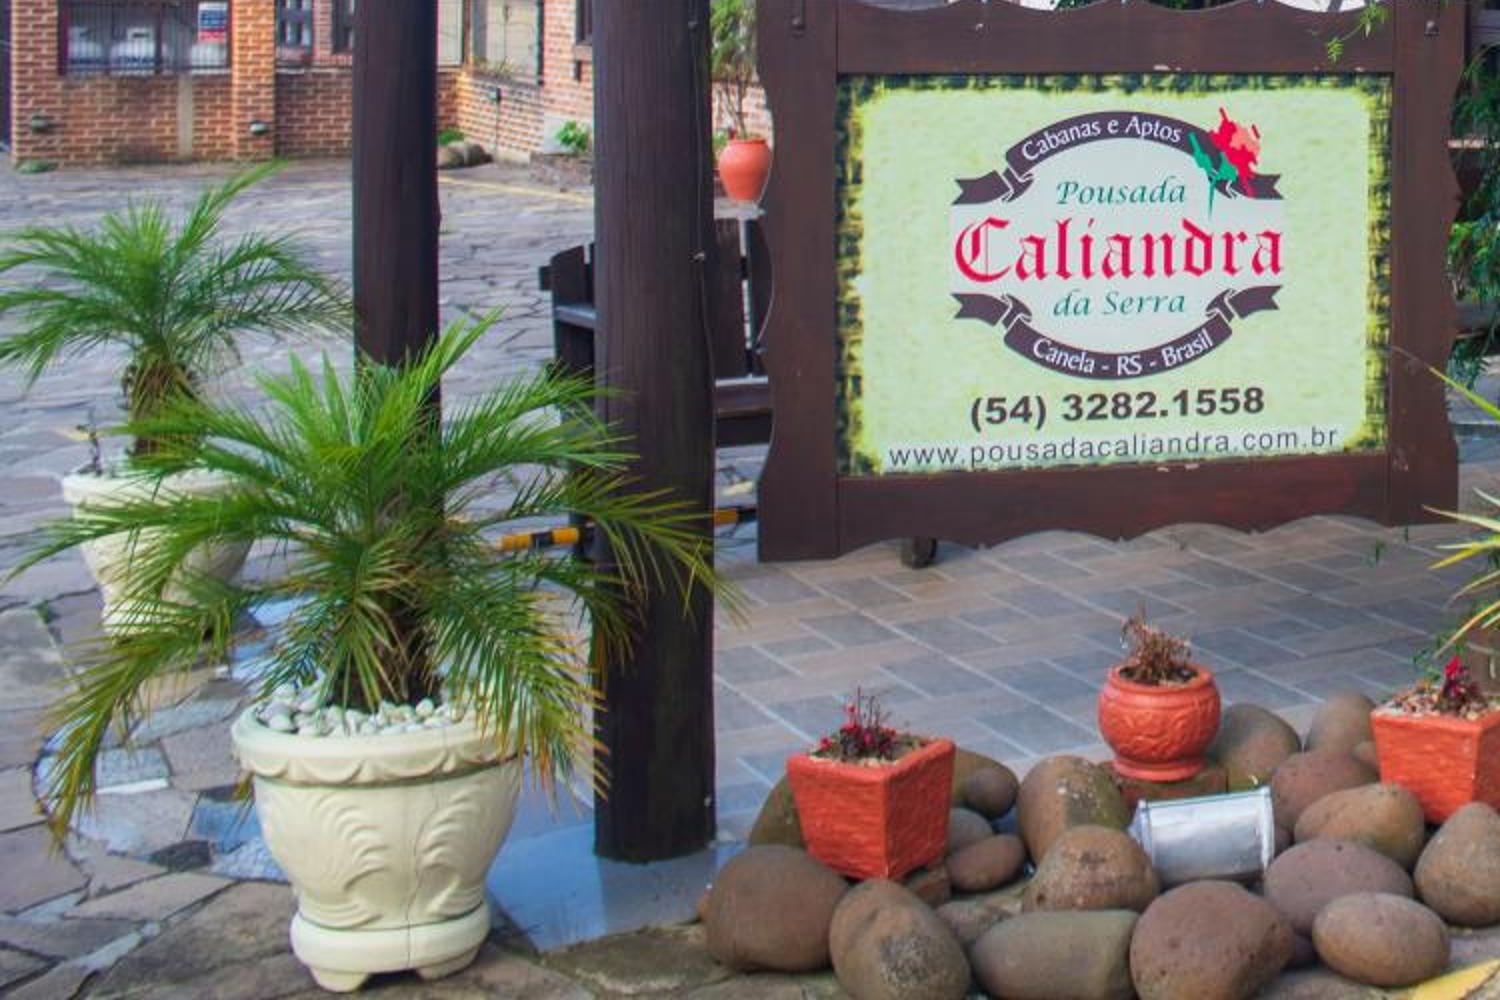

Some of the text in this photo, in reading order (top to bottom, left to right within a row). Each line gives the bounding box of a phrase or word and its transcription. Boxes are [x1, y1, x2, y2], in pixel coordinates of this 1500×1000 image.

[1021, 115, 1182, 160] Cabanas e Aptos
[1056, 175, 1185, 204] Pousada
[954, 216, 1284, 283] Caliandra
[1053, 288, 1186, 317] da Serra
[1033, 338, 1095, 374] Canela
[1117, 355, 1143, 376] RS
[1161, 328, 1213, 368] Brasil
[970, 387, 1265, 431] (54) 3282.1558
[889, 425, 1338, 468] www.pousadacaliandra.com.br
